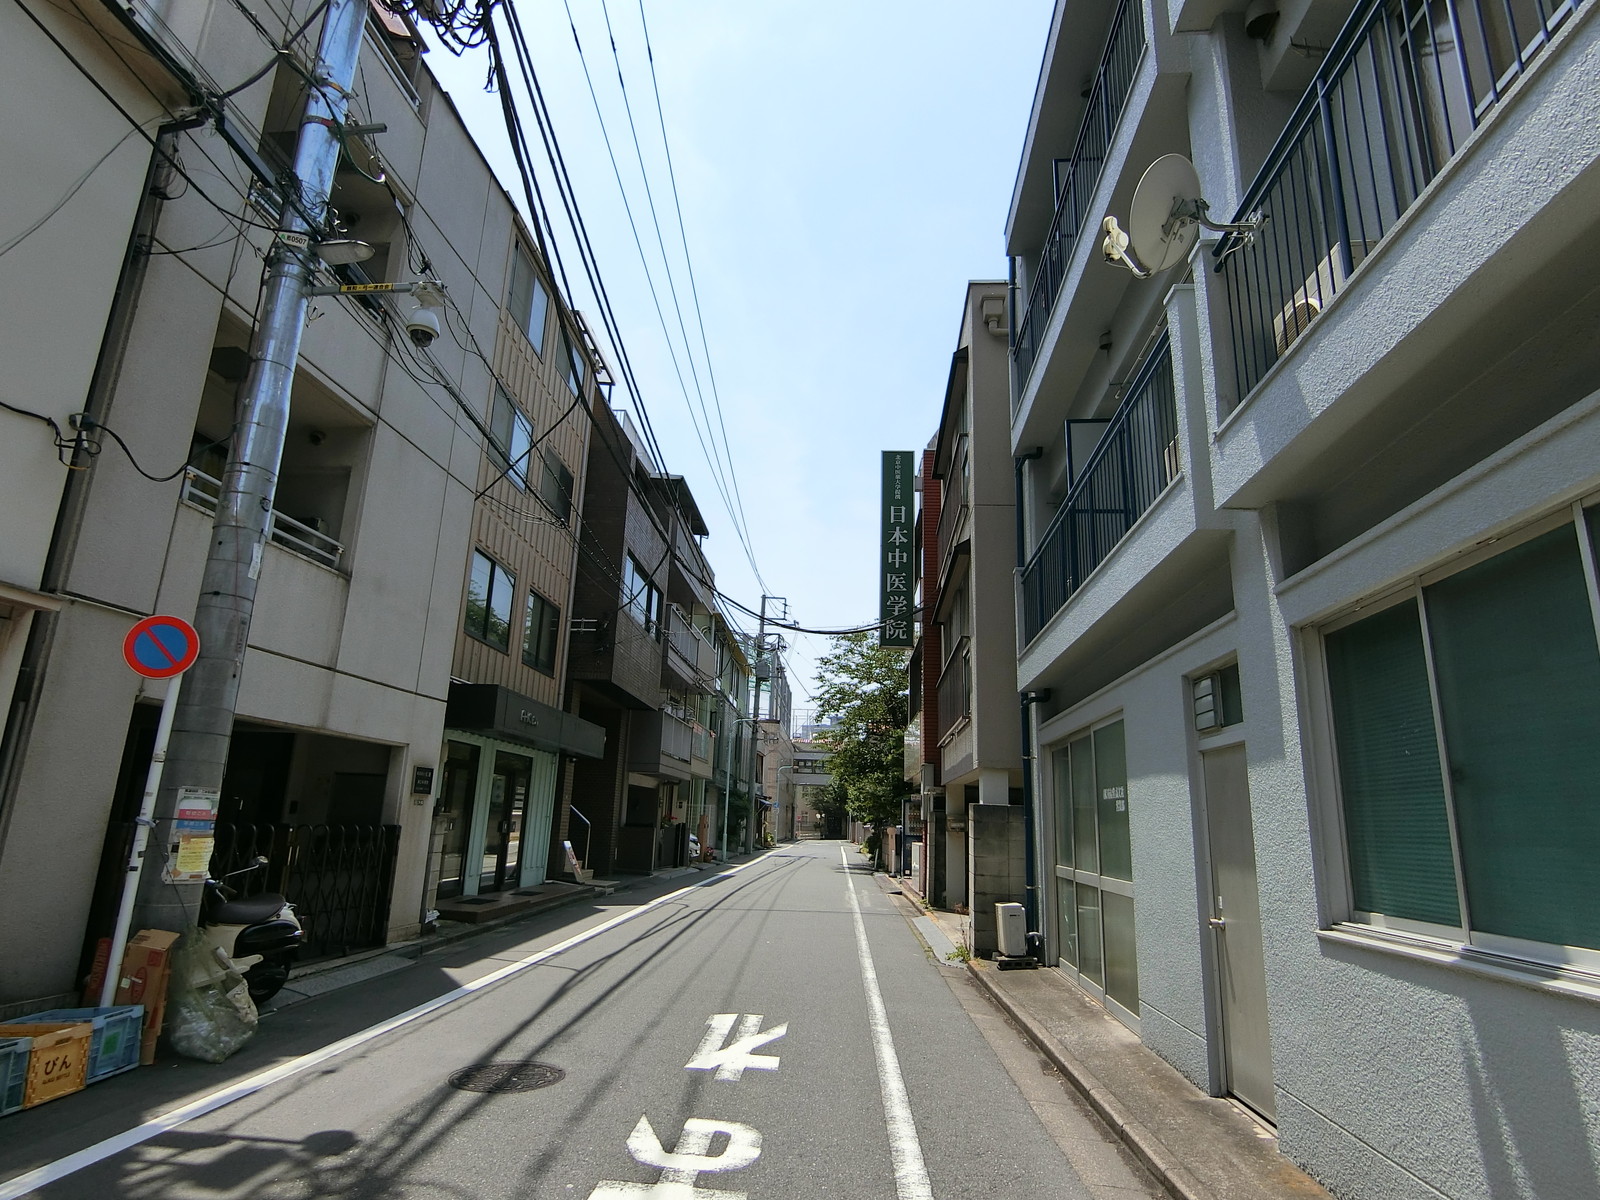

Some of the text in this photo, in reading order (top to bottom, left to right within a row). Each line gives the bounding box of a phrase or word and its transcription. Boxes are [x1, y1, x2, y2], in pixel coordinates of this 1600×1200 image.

[886, 505, 908, 640] 日本中医学院
[44, 1055, 72, 1075] びん
